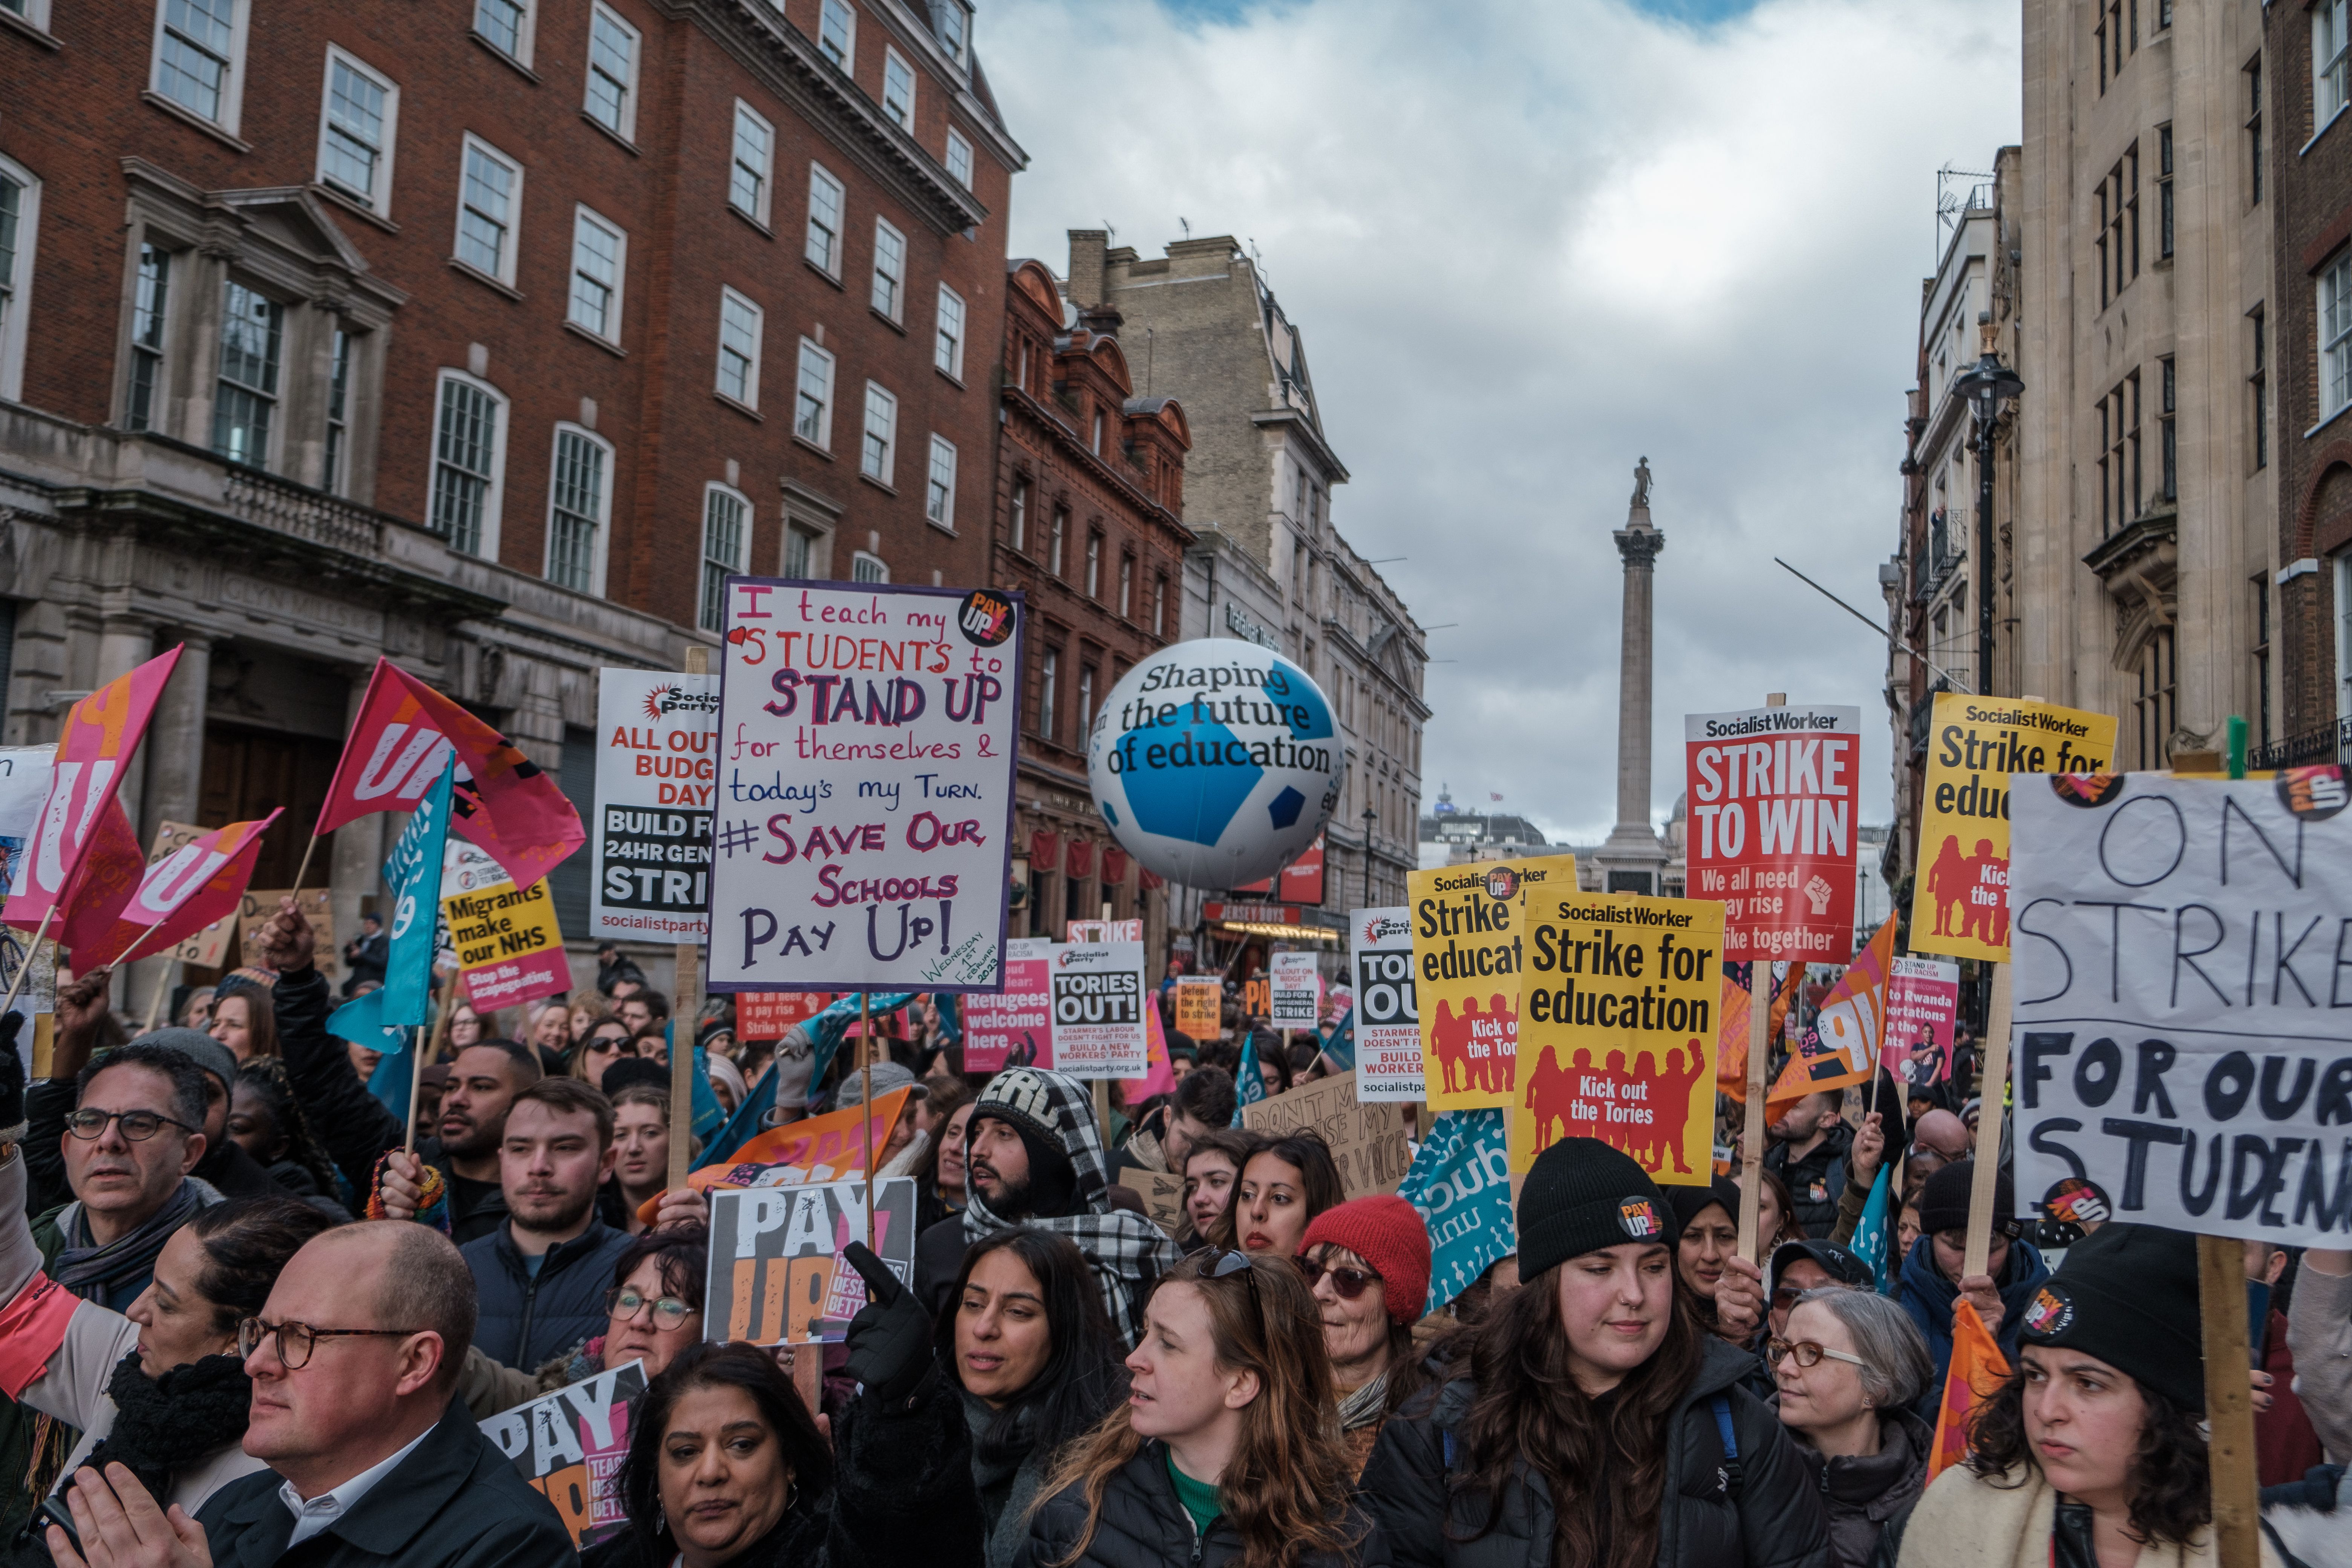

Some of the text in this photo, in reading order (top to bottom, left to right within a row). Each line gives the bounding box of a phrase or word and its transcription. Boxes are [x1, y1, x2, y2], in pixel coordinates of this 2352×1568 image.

[737, 586, 946, 644] I teach my
[972, 593, 1009, 618] PAY
[741, 628, 1002, 673] STUDENTS to
[1140, 661, 1290, 695] Shaping
[763, 668, 1002, 726] STAND UP
[1122, 698, 1178, 731] the
[1190, 692, 1310, 729] future
[611, 726, 662, 750] ALL
[730, 723, 999, 760] for themselves &
[1939, 725, 2104, 773] Strike for
[1107, 732, 1330, 774] of education
[636, 755, 714, 779] BUDG
[1696, 739, 1848, 802] STRIKE
[658, 783, 715, 805] DAY
[729, 768, 832, 813] today's
[859, 781, 900, 811] my
[608, 811, 687, 836] BUILD
[906, 811, 986, 853] OUR
[1695, 799, 1848, 859] TO WIN
[606, 841, 712, 863] 24HR GEN
[2099, 795, 2304, 889] ON
[605, 866, 706, 903] STRI
[811, 864, 959, 908] SCHOOLS
[1434, 873, 1485, 892] Socialis
[1490, 873, 1510, 883] PAY
[1701, 865, 1799, 891] We all need
[449, 885, 543, 920] Migrants
[1749, 892, 1783, 914] rise
[1971, 886, 1997, 906] the
[1221, 905, 1259, 922] JERSEY
[1418, 893, 1510, 938] Strike
[457, 918, 513, 943] make
[740, 900, 952, 969] PAY UP!
[1753, 926, 1833, 954] together
[462, 926, 546, 964] our NHS
[921, 931, 983, 982] WEDNESDAY
[1533, 924, 1713, 982] Strike for
[2018, 899, 2352, 1008] STRIKE
[1422, 935, 1522, 981] educat
[468, 965, 520, 986] Stop the
[472, 970, 554, 999] scapegoating
[1056, 974, 1137, 994] TORIES
[1914, 969, 1938, 977] RACISM
[745, 992, 760, 1001] We
[778, 992, 802, 1001] need
[968, 993, 1048, 1011] Refugees
[1181, 985, 1210, 995] Defend
[1889, 989, 1952, 1007] to Rwanda
[746, 1003, 795, 1018] a pay rise
[1058, 995, 1136, 1022] OUT!
[1181, 997, 1216, 1009] the right
[1181, 1009, 1216, 1019] to strike
[1275, 1007, 1313, 1017] STRIKE
[1530, 978, 1709, 1033] education
[746, 1022, 776, 1034] Strike
[968, 1011, 1045, 1028] welcome
[1472, 1018, 1501, 1037] Kick
[1898, 1021, 1918, 1033] the
[968, 1031, 1008, 1048] here
[1364, 1038, 1409, 1047] DOESN'T
[1372, 1028, 1420, 1037] STARMER
[1059, 1051, 1109, 1060] WORKERS'
[1380, 1052, 1421, 1062] BUILD
[1467, 1041, 1490, 1058] the
[1058, 1064, 1141, 1073] socialistparty.org.uk
[1366, 1063, 1424, 1073] WORKER
[2021, 1031, 2352, 1126] FOR OUR
[1580, 1075, 1648, 1100] Kick out
[1360, 1101, 1391, 1140] MY
[1571, 1099, 1653, 1124] the Tories
[1355, 1130, 1407, 1188] VOICE
[735, 1181, 887, 1258] PAY
[1622, 1202, 1649, 1219] PAY
[728, 1257, 834, 1344] UP
[479, 1372, 617, 1477] PAY
